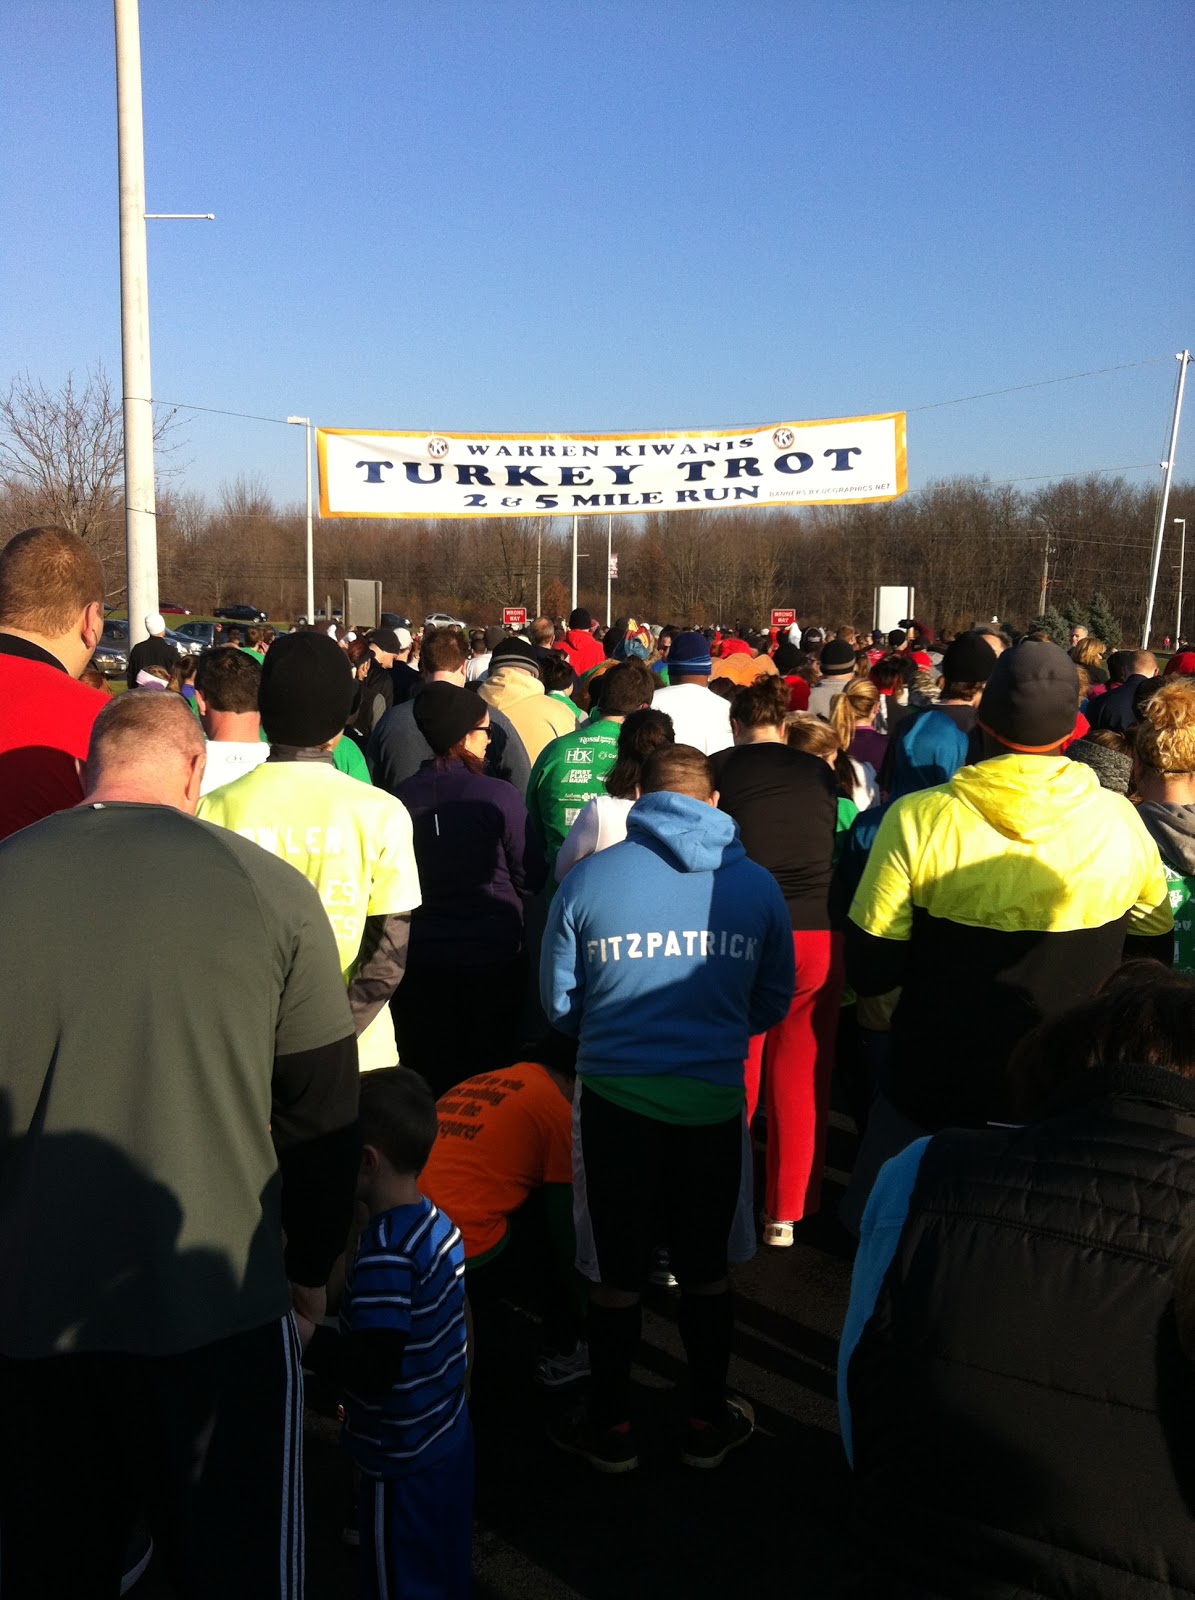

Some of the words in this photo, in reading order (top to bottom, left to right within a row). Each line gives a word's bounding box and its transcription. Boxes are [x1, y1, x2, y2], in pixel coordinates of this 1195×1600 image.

[467, 445, 600, 457] WARREN
[615, 437, 754, 456] KIWANIS
[355, 460, 644, 487] TURKEY
[677, 447, 862, 482] TROT
[463, 494, 488, 507] 2
[500, 497, 523, 507] &
[535, 494, 559, 509] 5
[572, 491, 663, 507] MILE
[675, 485, 760, 503] RUN
[769, 489, 807, 498] BANNERS
[587, 930, 758, 963] FITZPATRICK
